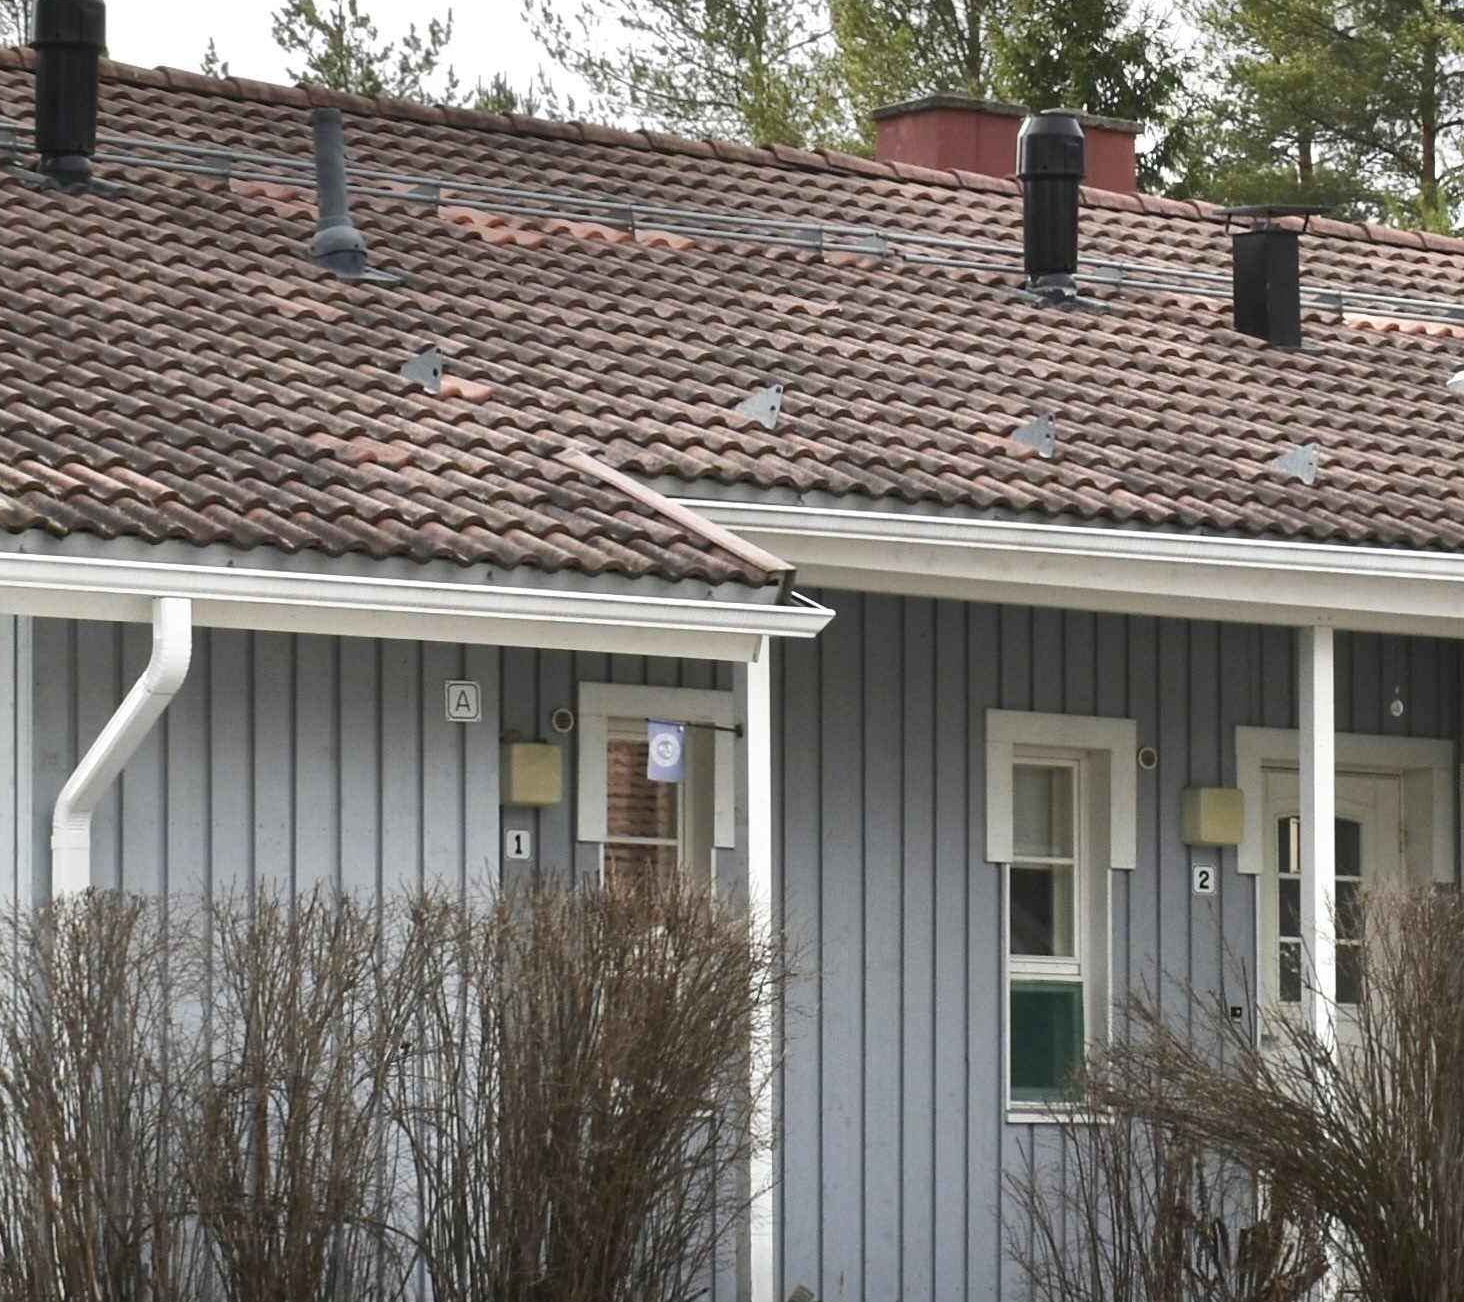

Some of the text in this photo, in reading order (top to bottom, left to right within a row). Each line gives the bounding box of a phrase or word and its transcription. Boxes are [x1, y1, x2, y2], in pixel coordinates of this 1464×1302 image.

[455, 690, 471, 712] A
[514, 834, 523, 855] 1
[1199, 870, 1209, 889] 2
